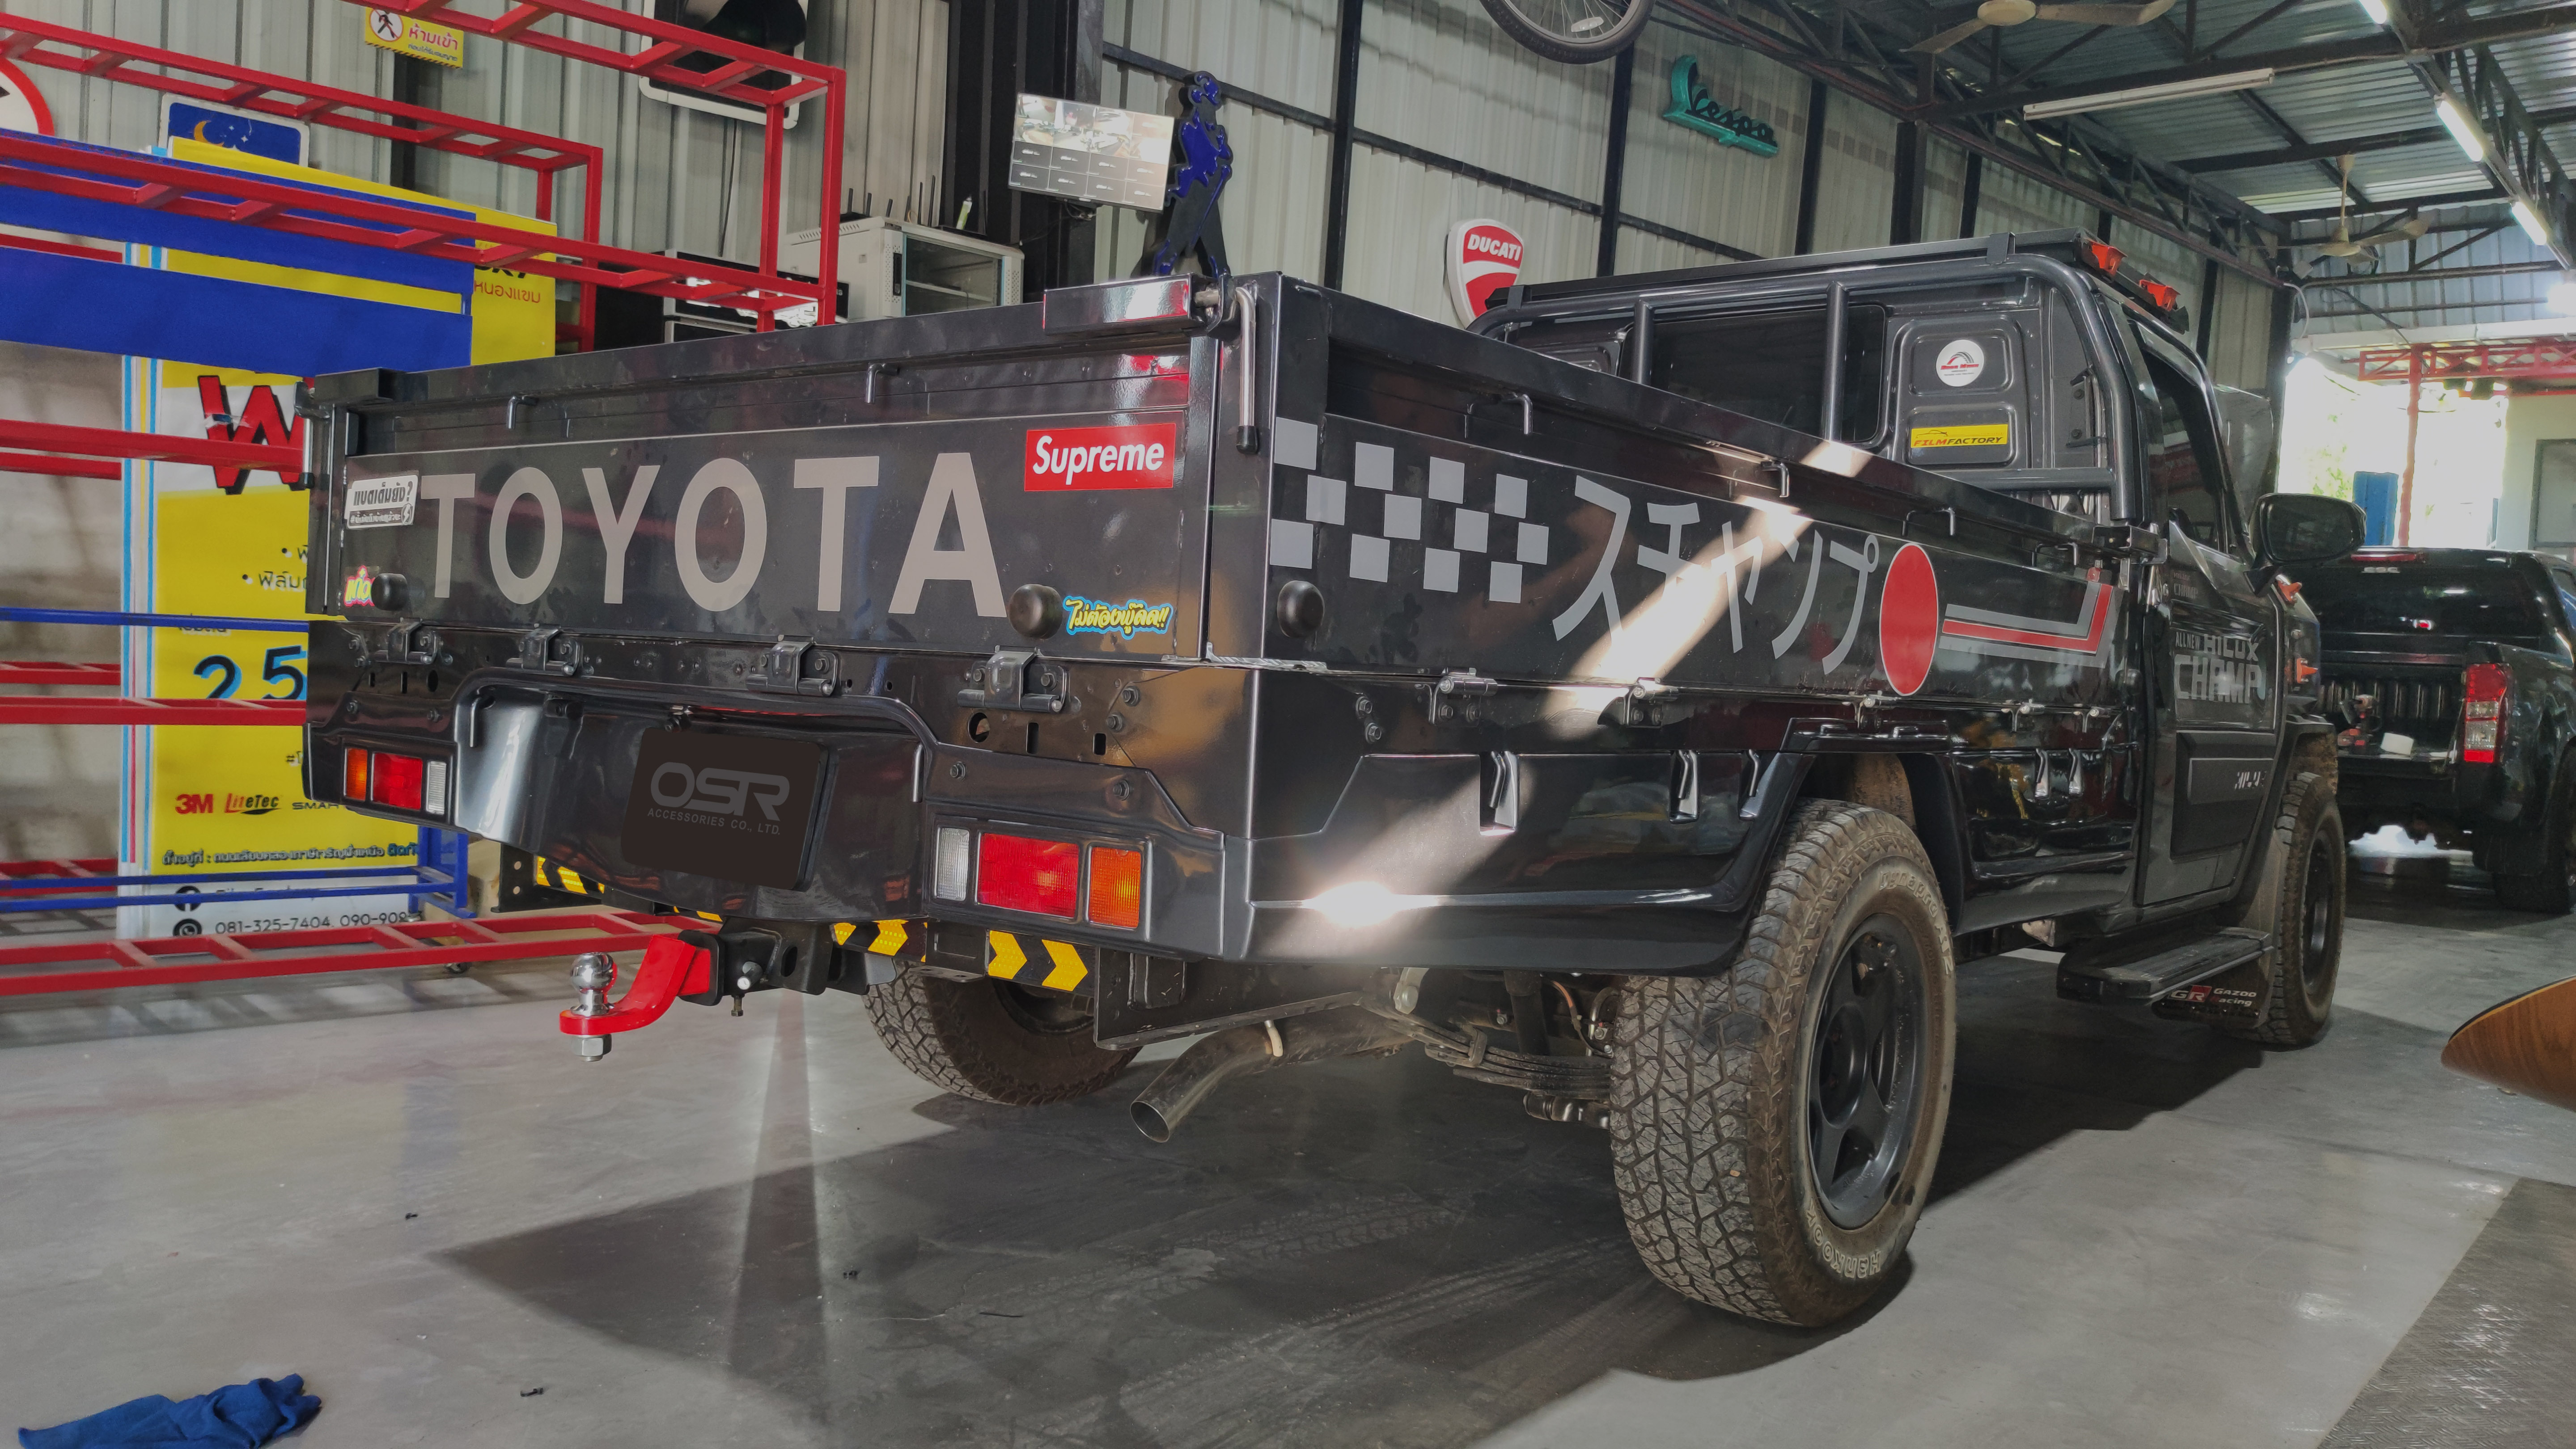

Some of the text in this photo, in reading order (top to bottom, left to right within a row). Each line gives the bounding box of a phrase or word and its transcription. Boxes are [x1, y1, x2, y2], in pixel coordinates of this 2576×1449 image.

[409, 23, 458, 50] ห้ามเข้า
[1671, 55, 1779, 153] Vespa
[1467, 233, 1521, 261] DUCATI
[1032, 435, 1165, 485] Supreme
[421, 453, 1007, 618] TOYOTA
[2204, 634, 2259, 661] HILUX
[2174, 654, 2262, 704] CHAMP
[175, 794, 213, 814] 3M
[2170, 988, 2257, 1001] GR GAZOO
